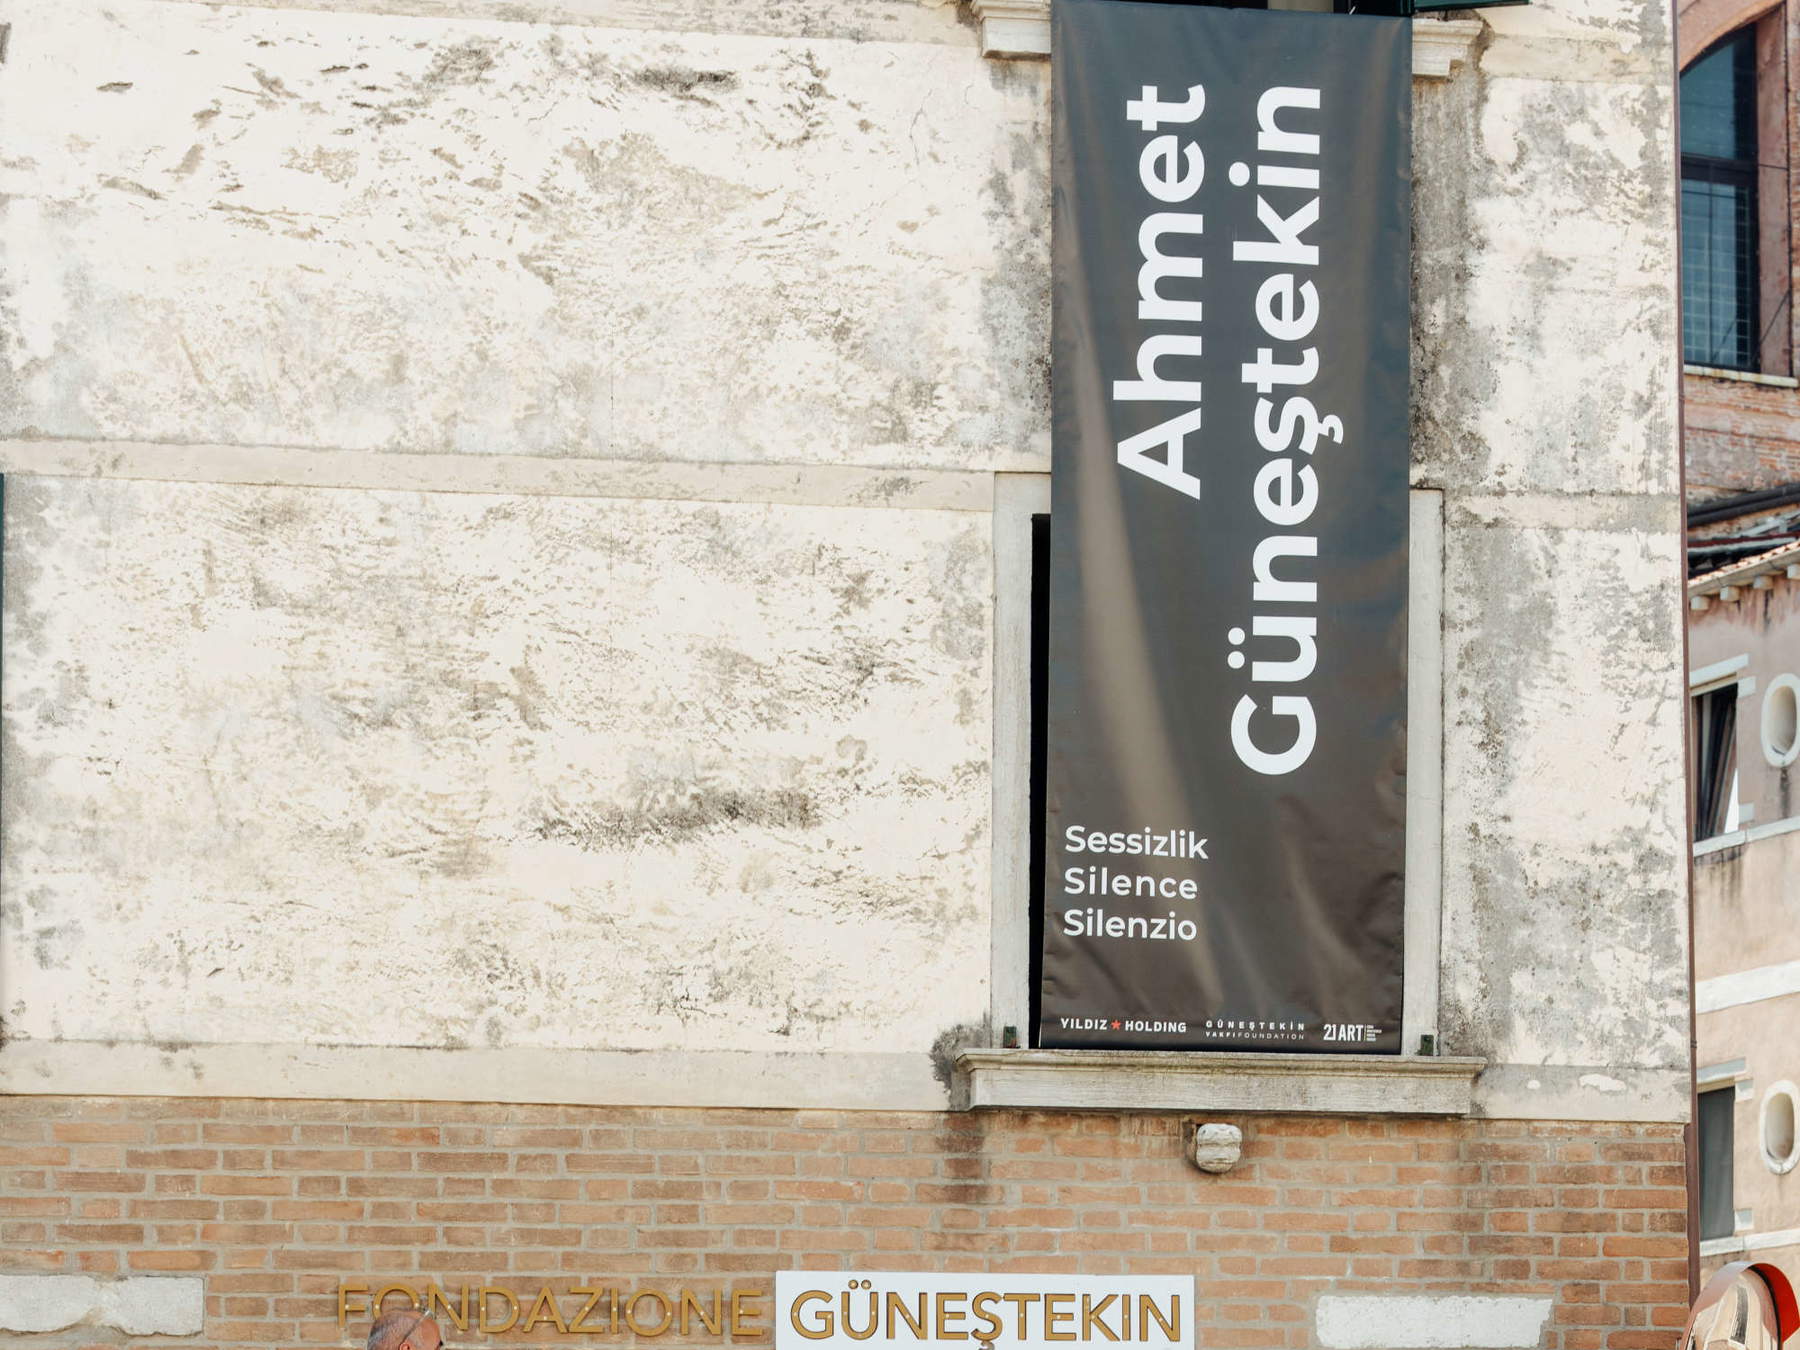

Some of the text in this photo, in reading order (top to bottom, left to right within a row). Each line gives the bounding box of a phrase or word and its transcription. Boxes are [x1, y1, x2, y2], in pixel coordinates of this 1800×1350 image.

[1112, 84, 1206, 501] Ahmet
[1227, 86, 1344, 775] Güneştekin
[1065, 825, 1209, 860] Sessizlik
[1064, 866, 1198, 900] Silence
[1063, 908, 1198, 941] Silenzio
[1060, 1017, 1187, 1033] YILDIZ HOLDING
